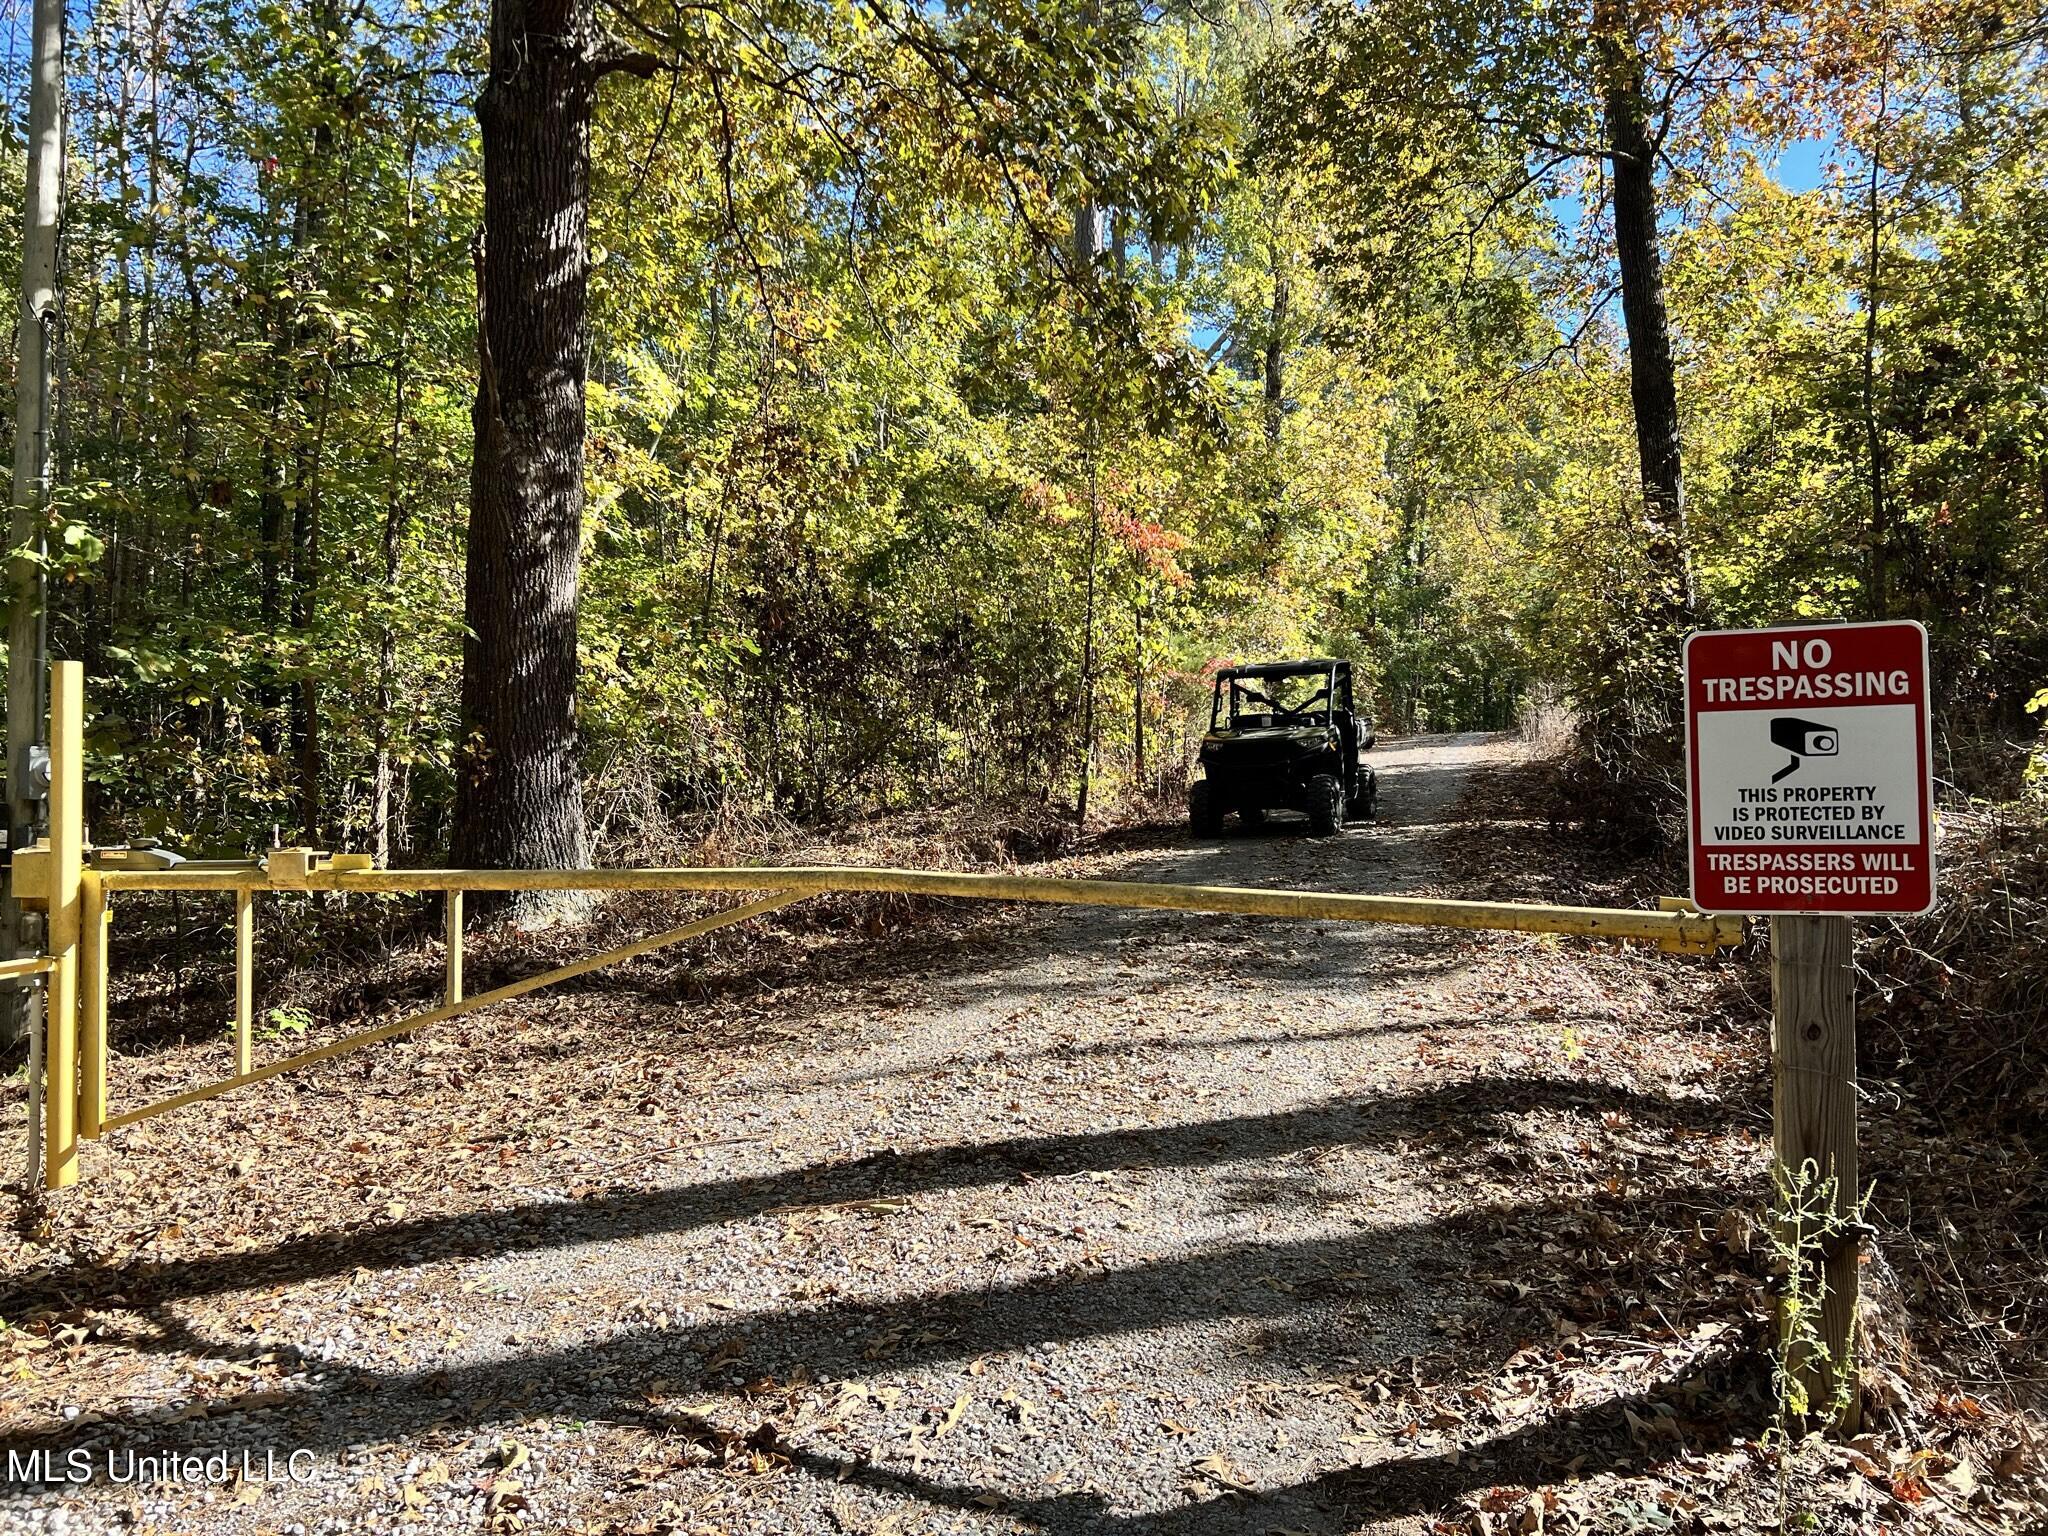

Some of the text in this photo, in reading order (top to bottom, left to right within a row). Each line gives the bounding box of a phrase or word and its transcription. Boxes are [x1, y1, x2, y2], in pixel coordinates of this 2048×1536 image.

[1772, 639, 1831, 670] NO
[1703, 670, 1909, 702] TRESPASSING
[1738, 786, 1877, 802] THIS PROPERTY
[1733, 805, 1886, 821] IS PROTECTED BY
[1714, 825, 1905, 840] VIDEO SURVEILLANCE
[1707, 853, 1915, 871] TRESPASSERS WILL
[1724, 877, 1898, 894] BE PROSECUTED
